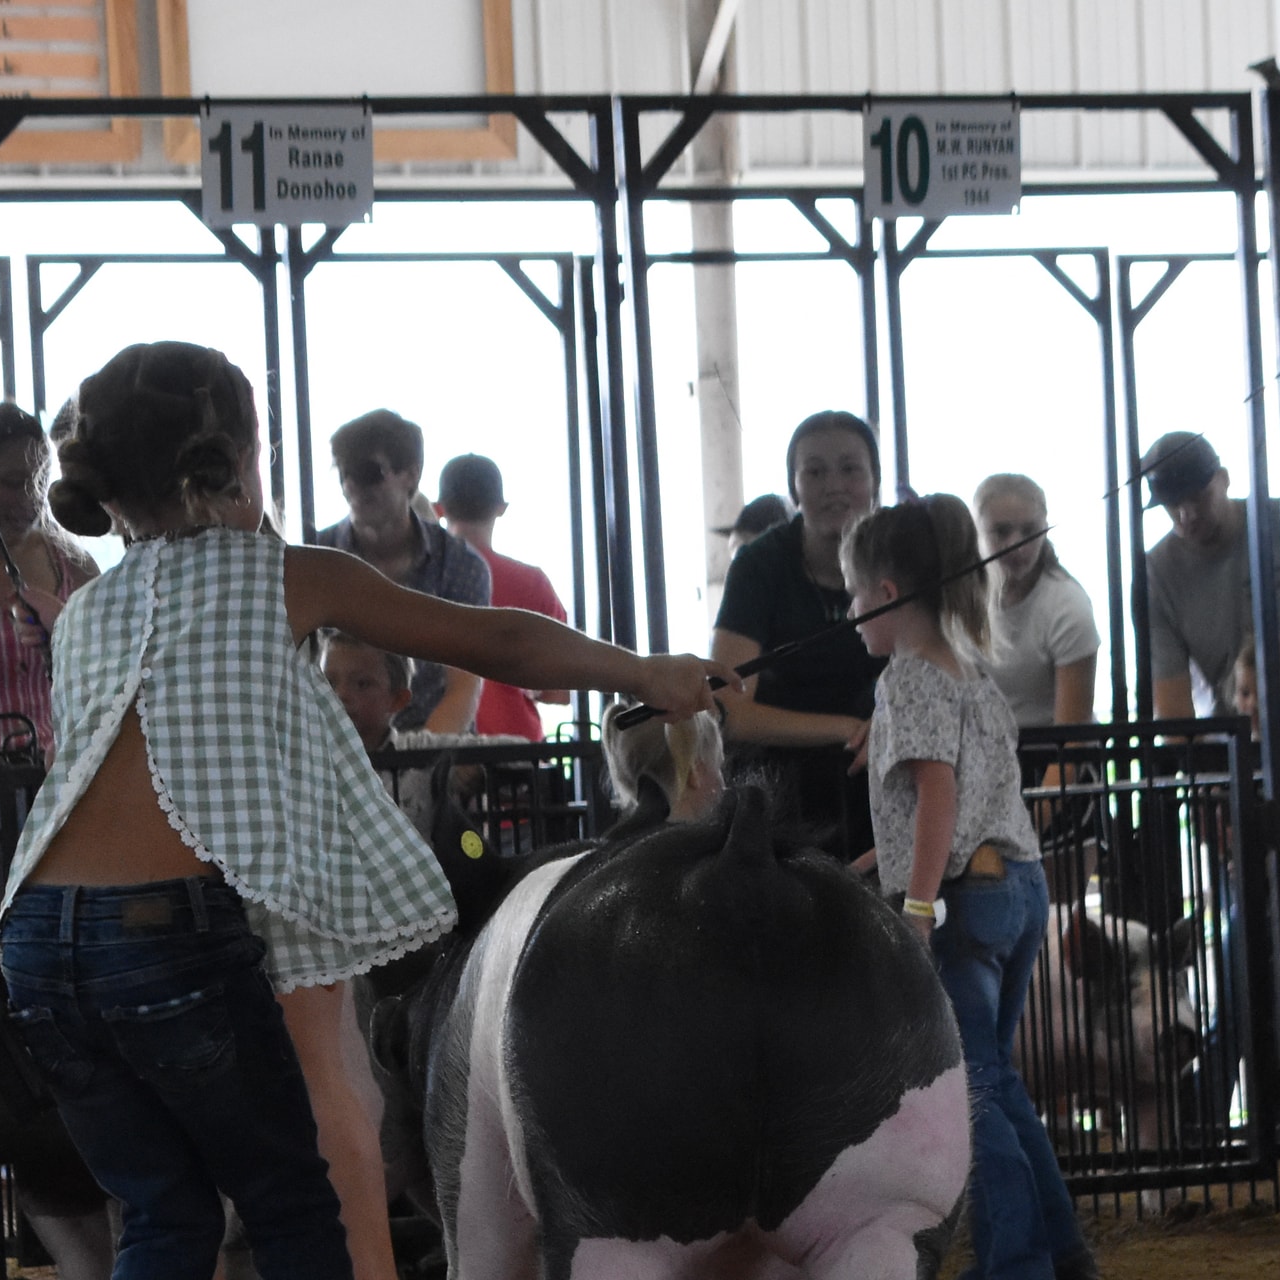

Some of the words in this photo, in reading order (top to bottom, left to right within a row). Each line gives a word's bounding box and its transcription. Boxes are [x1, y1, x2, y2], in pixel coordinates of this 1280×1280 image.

[269, 126, 282, 141] In
[287, 125, 347, 142] Memory
[351, 126, 366, 140] of
[950, 121, 996, 134] Memory
[208, 120, 266, 212] 11
[288, 147, 345, 168] Ranae
[871, 115, 930, 206] 10
[277, 178, 357, 200] Donohoe
